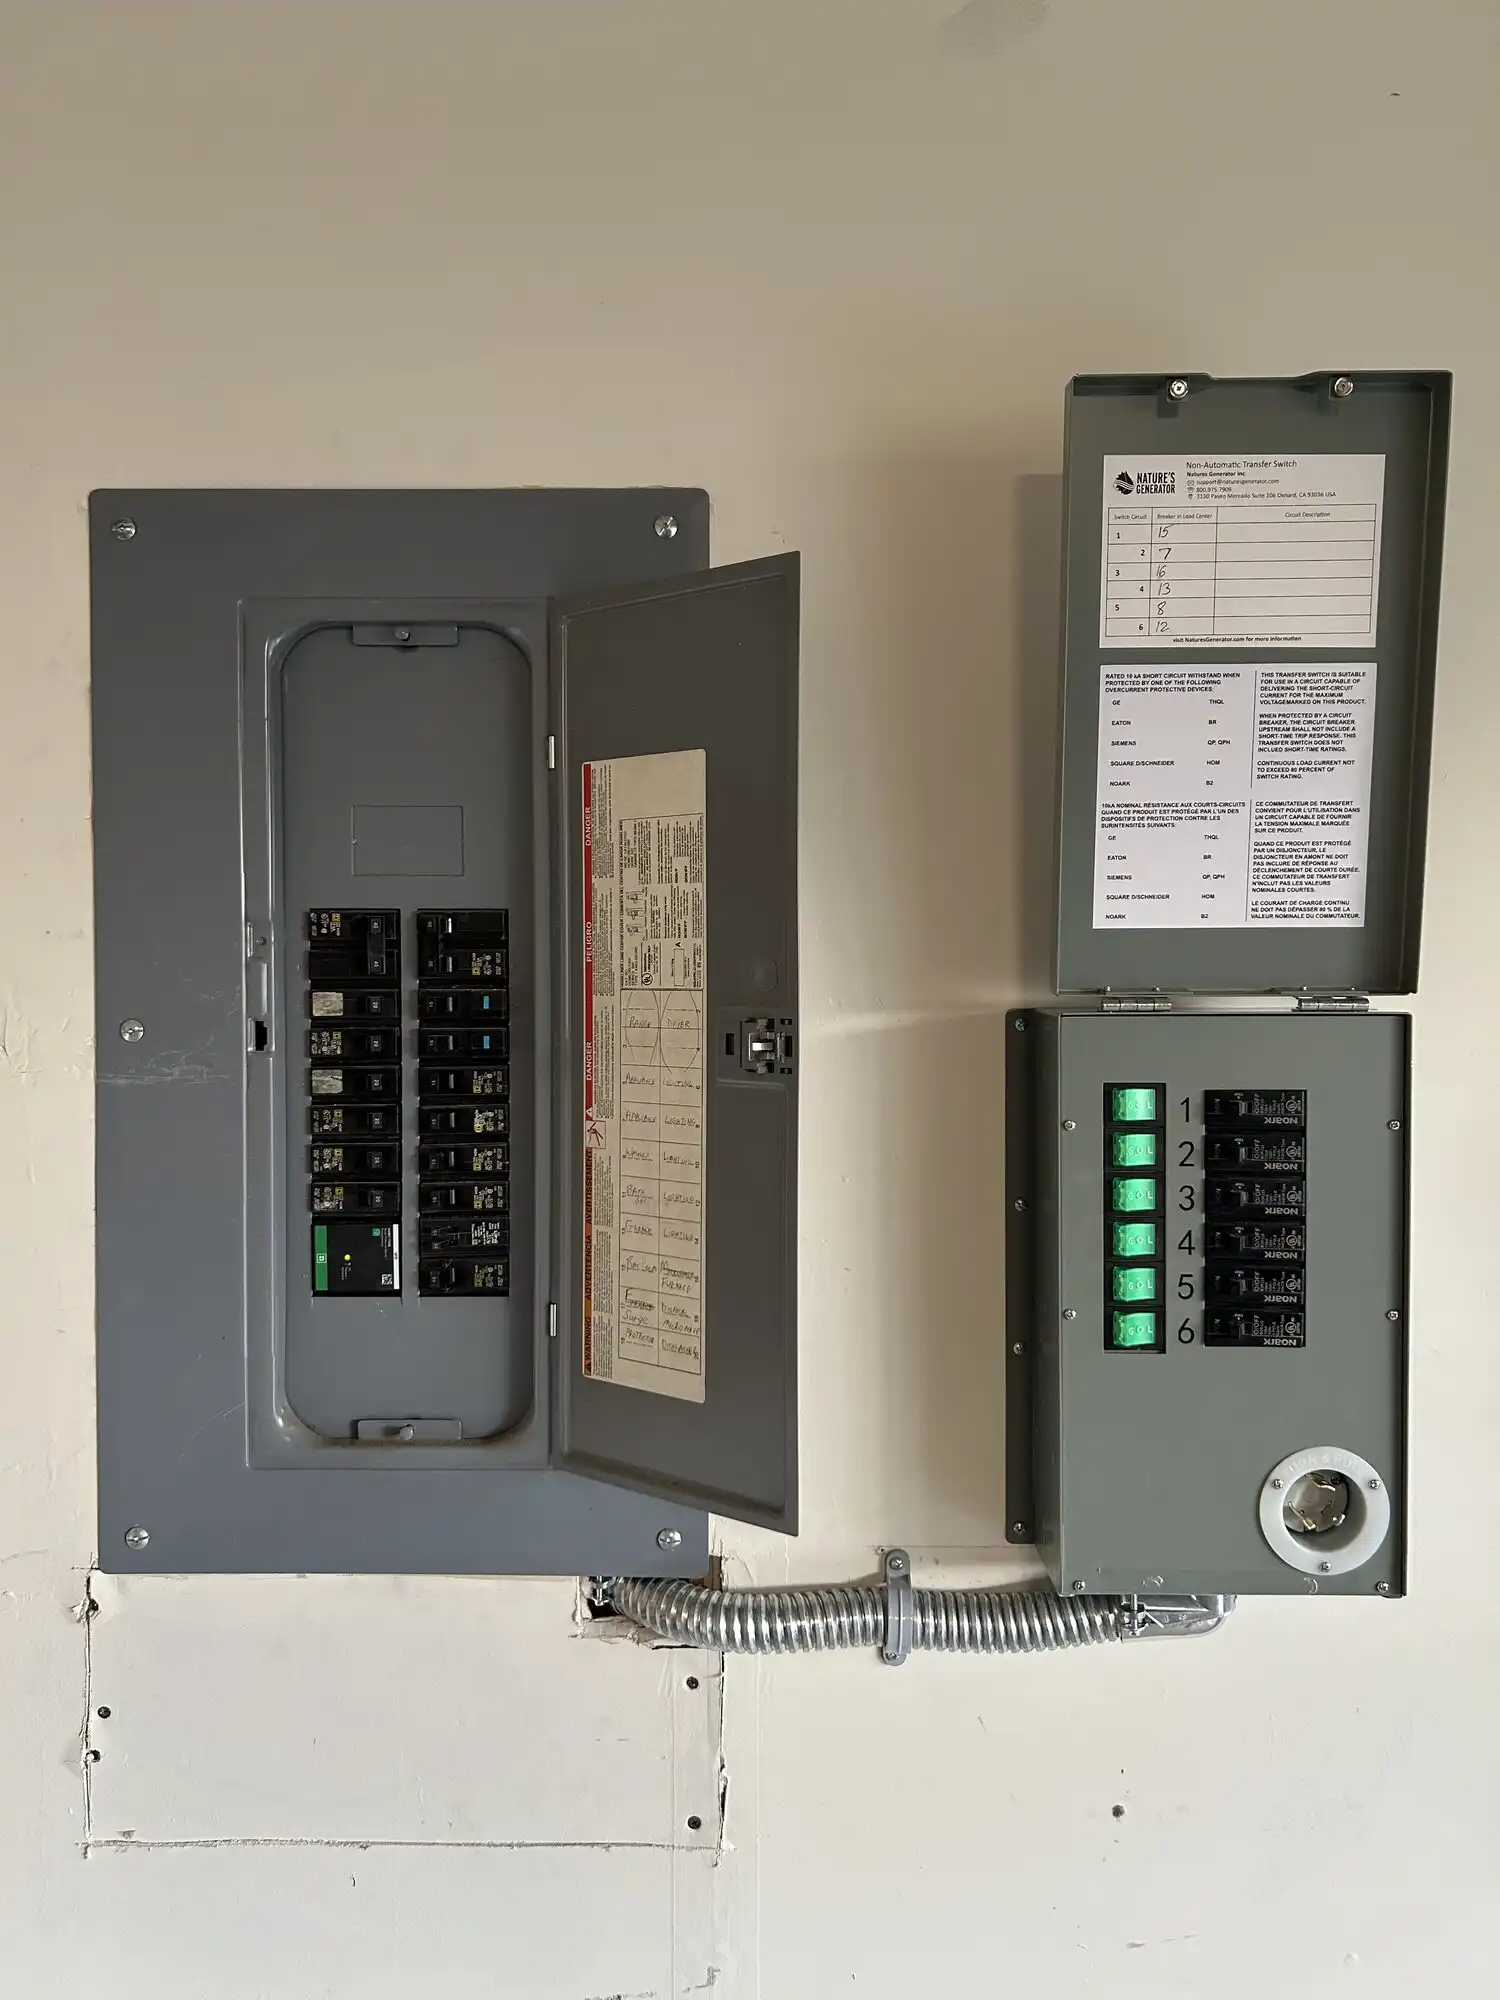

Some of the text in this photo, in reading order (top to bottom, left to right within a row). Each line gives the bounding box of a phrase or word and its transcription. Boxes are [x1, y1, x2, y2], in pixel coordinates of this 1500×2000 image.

[1136, 472, 1176, 484] NATURE'S
[1136, 484, 1176, 495] GENERATOR
[1158, 526, 1172, 538] 15
[1158, 547, 1172, 560] 7
[1156, 564, 1166, 578] 16
[1158, 582, 1171, 596] 13
[1157, 601, 1167, 615] 8
[1155, 621, 1170, 633] 12
[1180, 1097, 1190, 1122] 1
[1178, 1141, 1194, 1166] 2
[1179, 1185, 1195, 1211] 3
[1178, 1230, 1195, 1255] 4
[1178, 1274, 1194, 1300] 5
[1178, 1318, 1194, 1344] 6
